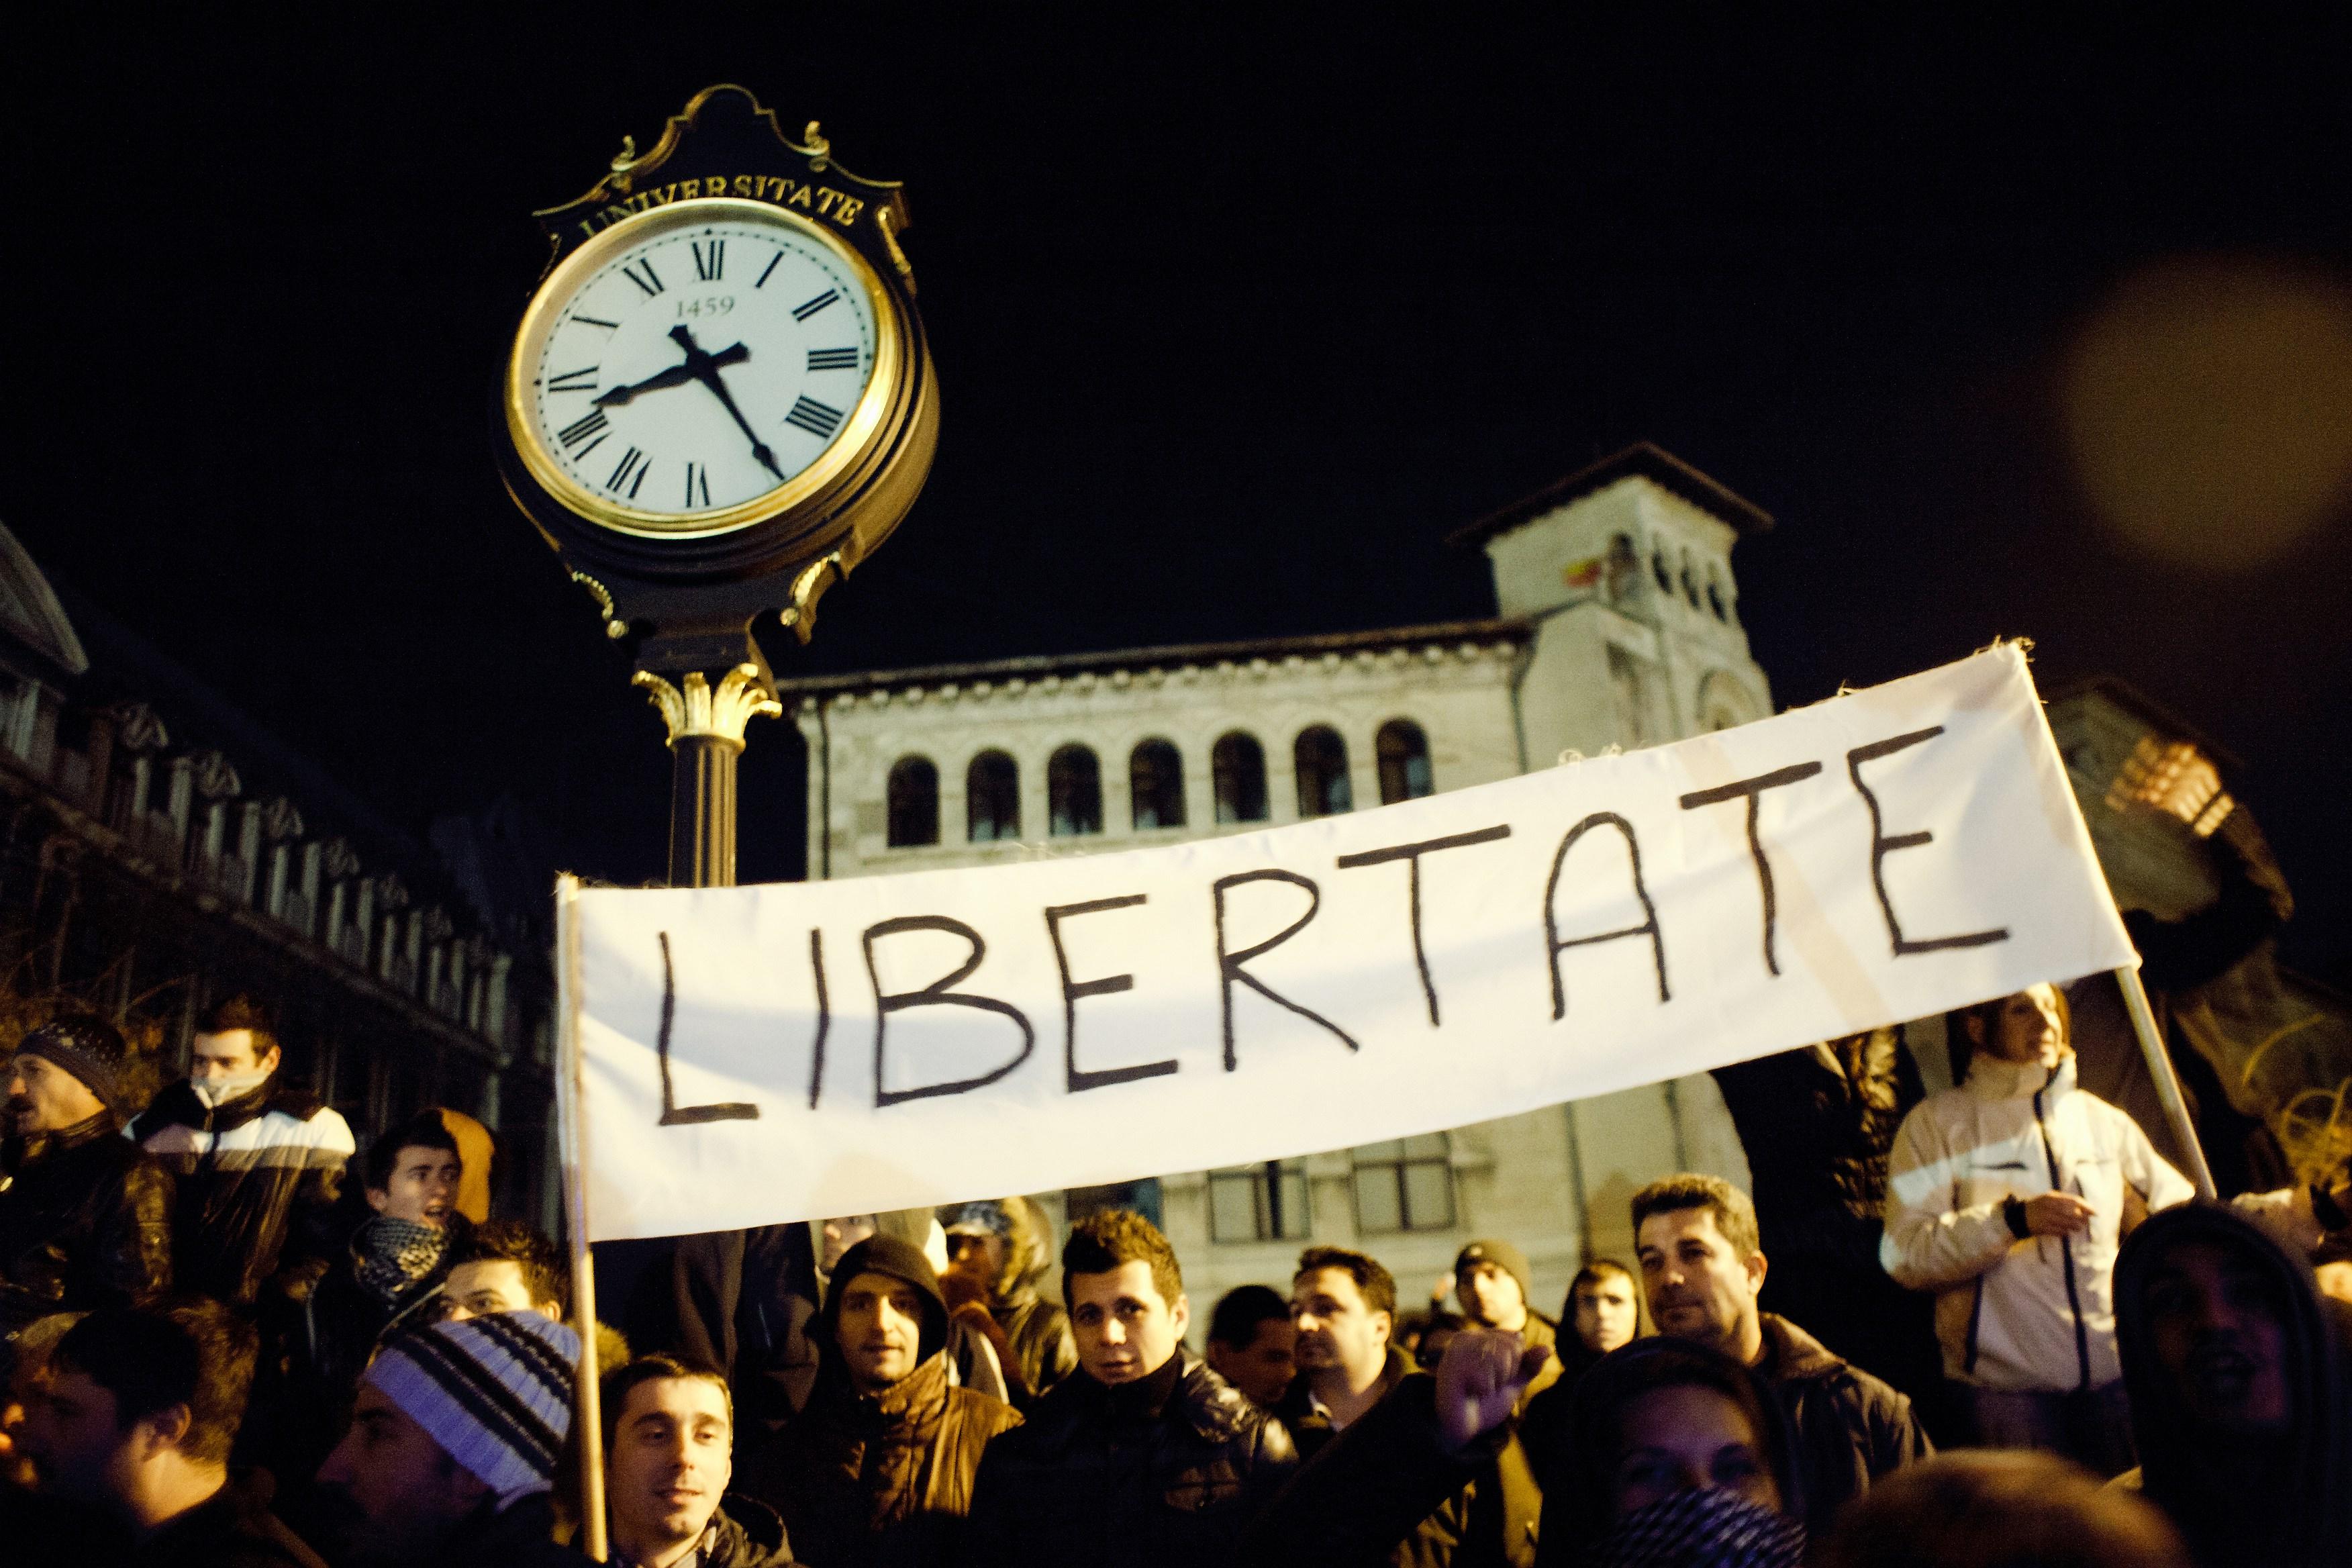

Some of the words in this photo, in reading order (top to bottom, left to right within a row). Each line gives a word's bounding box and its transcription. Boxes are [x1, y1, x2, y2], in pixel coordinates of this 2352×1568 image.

[675, 296, 735, 318] 1459
[792, 288, 840, 323] II
[807, 346, 859, 371] III
[657, 725, 2010, 1127] LIBERTATE
